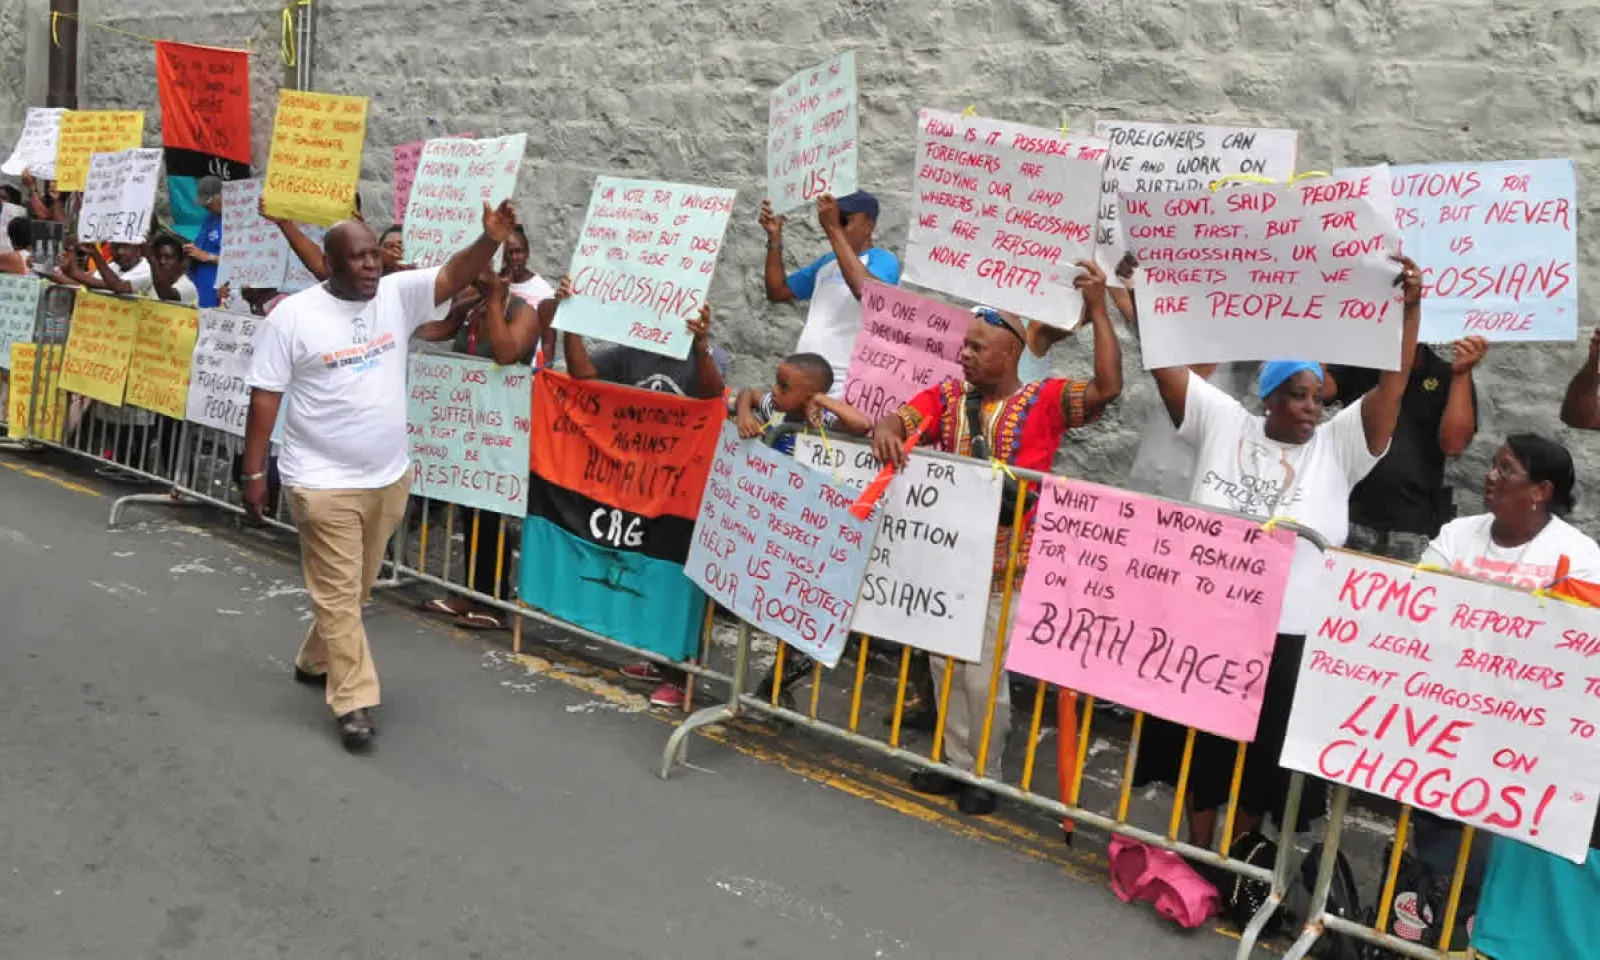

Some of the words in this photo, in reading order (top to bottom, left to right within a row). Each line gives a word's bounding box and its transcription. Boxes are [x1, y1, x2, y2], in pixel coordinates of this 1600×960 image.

[964, 128, 976, 143] IS
[985, 132, 1002, 145] IT
[1012, 133, 1072, 157] POSSIBLE
[1077, 146, 1108, 161] THAT
[1108, 127, 1206, 150] FOREIGNERS
[1221, 131, 1259, 151] CAN
[924, 142, 1000, 174] FOREIGNERS
[1018, 162, 1045, 179] ARE
[1140, 160, 1165, 174] AND
[1176, 156, 1221, 174] WORK
[1239, 159, 1267, 174] ON
[623, 188, 646, 204] VOTE
[652, 189, 672, 208] FOR
[801, 162, 836, 201] US!
[917, 164, 978, 191] ENJOYING
[988, 180, 1013, 200] OUR
[1027, 189, 1064, 206] LAND
[1126, 200, 1152, 218] UK
[1164, 197, 1215, 217] GOVT.
[1226, 191, 1278, 213] SAID
[1300, 176, 1372, 206] PEOPLE
[1501, 174, 1531, 193] FOR
[672, 215, 690, 226] OF
[981, 203, 999, 218] WE
[1004, 206, 1092, 244] CHAGOSSIANS
[1130, 224, 1177, 239] COME
[1265, 219, 1302, 239] BUT
[1321, 211, 1357, 232] FOR
[1439, 204, 1479, 222] BUT
[1484, 198, 1571, 232] NEVER
[585, 223, 619, 241] HUMAN
[625, 228, 654, 245] RIGHT
[657, 231, 680, 246] BUT
[689, 235, 720, 253] DOES
[918, 213, 938, 229] WE
[951, 220, 981, 241] ARE
[991, 229, 1062, 264] PERSONA
[1292, 245, 1317, 262] UK
[1332, 235, 1385, 258] GOVT.
[1449, 235, 1475, 255] US
[680, 256, 694, 270] TO
[928, 245, 971, 270] NONE
[569, 265, 705, 320] CHAGOSSIANS
[1143, 267, 1227, 285] FORGETS
[1248, 270, 1300, 284] THAT
[1320, 267, 1354, 283] WE
[866, 293, 886, 311] NO
[891, 302, 918, 322] ONE
[926, 313, 951, 333] CAN
[1153, 295, 1190, 316] ARE
[1206, 291, 1328, 319] PEOPLE
[1462, 307, 1536, 331] PEOPLE
[628, 321, 672, 344] PEOPLE
[869, 320, 913, 346] DECIDE
[925, 337, 945, 356] FOR
[460, 366, 488, 385] DOES
[503, 374, 526, 388] NOT
[911, 365, 934, 386] WE
[449, 387, 472, 407] OUR
[429, 404, 504, 430] SUFFERINGS
[513, 416, 530, 435] AND
[463, 430, 477, 445] OF
[481, 434, 514, 448] ABODE
[610, 431, 680, 454] AGAINST
[464, 450, 480, 462] BE
[722, 436, 741, 457] WE
[746, 452, 779, 480] WANT
[787, 470, 805, 491] TO
[927, 462, 957, 485] FOR
[713, 458, 734, 482] OUR
[736, 475, 789, 512] CULTURE
[800, 507, 829, 530] AND
[837, 525, 864, 550] FOR
[905, 483, 939, 508] NO
[589, 507, 645, 547] CRG
[708, 478, 738, 511] PEOPLE
[746, 503, 761, 521] TO
[766, 512, 821, 549] RESPECT
[828, 544, 848, 563] US
[1118, 500, 1136, 519] IS
[1156, 508, 1224, 537] WRONG
[1242, 527, 1264, 545] IF
[704, 500, 716, 520] AS
[719, 514, 757, 545] HUMAN
[764, 539, 828, 580] BEINGS!
[1041, 511, 1131, 547] SOMEONE
[1153, 538, 1172, 556] IS
[1189, 544, 1268, 576] ASKING
[697, 523, 738, 560] HELP
[746, 555, 773, 581] US
[784, 570, 853, 624] PROTECT
[704, 562, 740, 609] OUR
[1037, 539, 1067, 563] FOR
[1077, 550, 1109, 573] HIS
[1125, 558, 1182, 585] RIGHT
[1195, 575, 1216, 595] TO
[1226, 585, 1266, 606] LIVE
[1044, 571, 1068, 588] ON
[1083, 579, 1116, 600] HIS
[1025, 602, 1136, 670] BIRTH
[1450, 603, 1547, 640] REPORT
[1317, 616, 1359, 646] NO
[1367, 632, 1434, 663] LEGAL
[1455, 648, 1566, 691] BARRIERS
[1307, 649, 1400, 689] PREVENT
[1404, 670, 1549, 727] CHAGOSSIANS
[1568, 717, 1596, 739] TO
[1338, 694, 1477, 760] LIVE
[1491, 747, 1540, 774] ON
